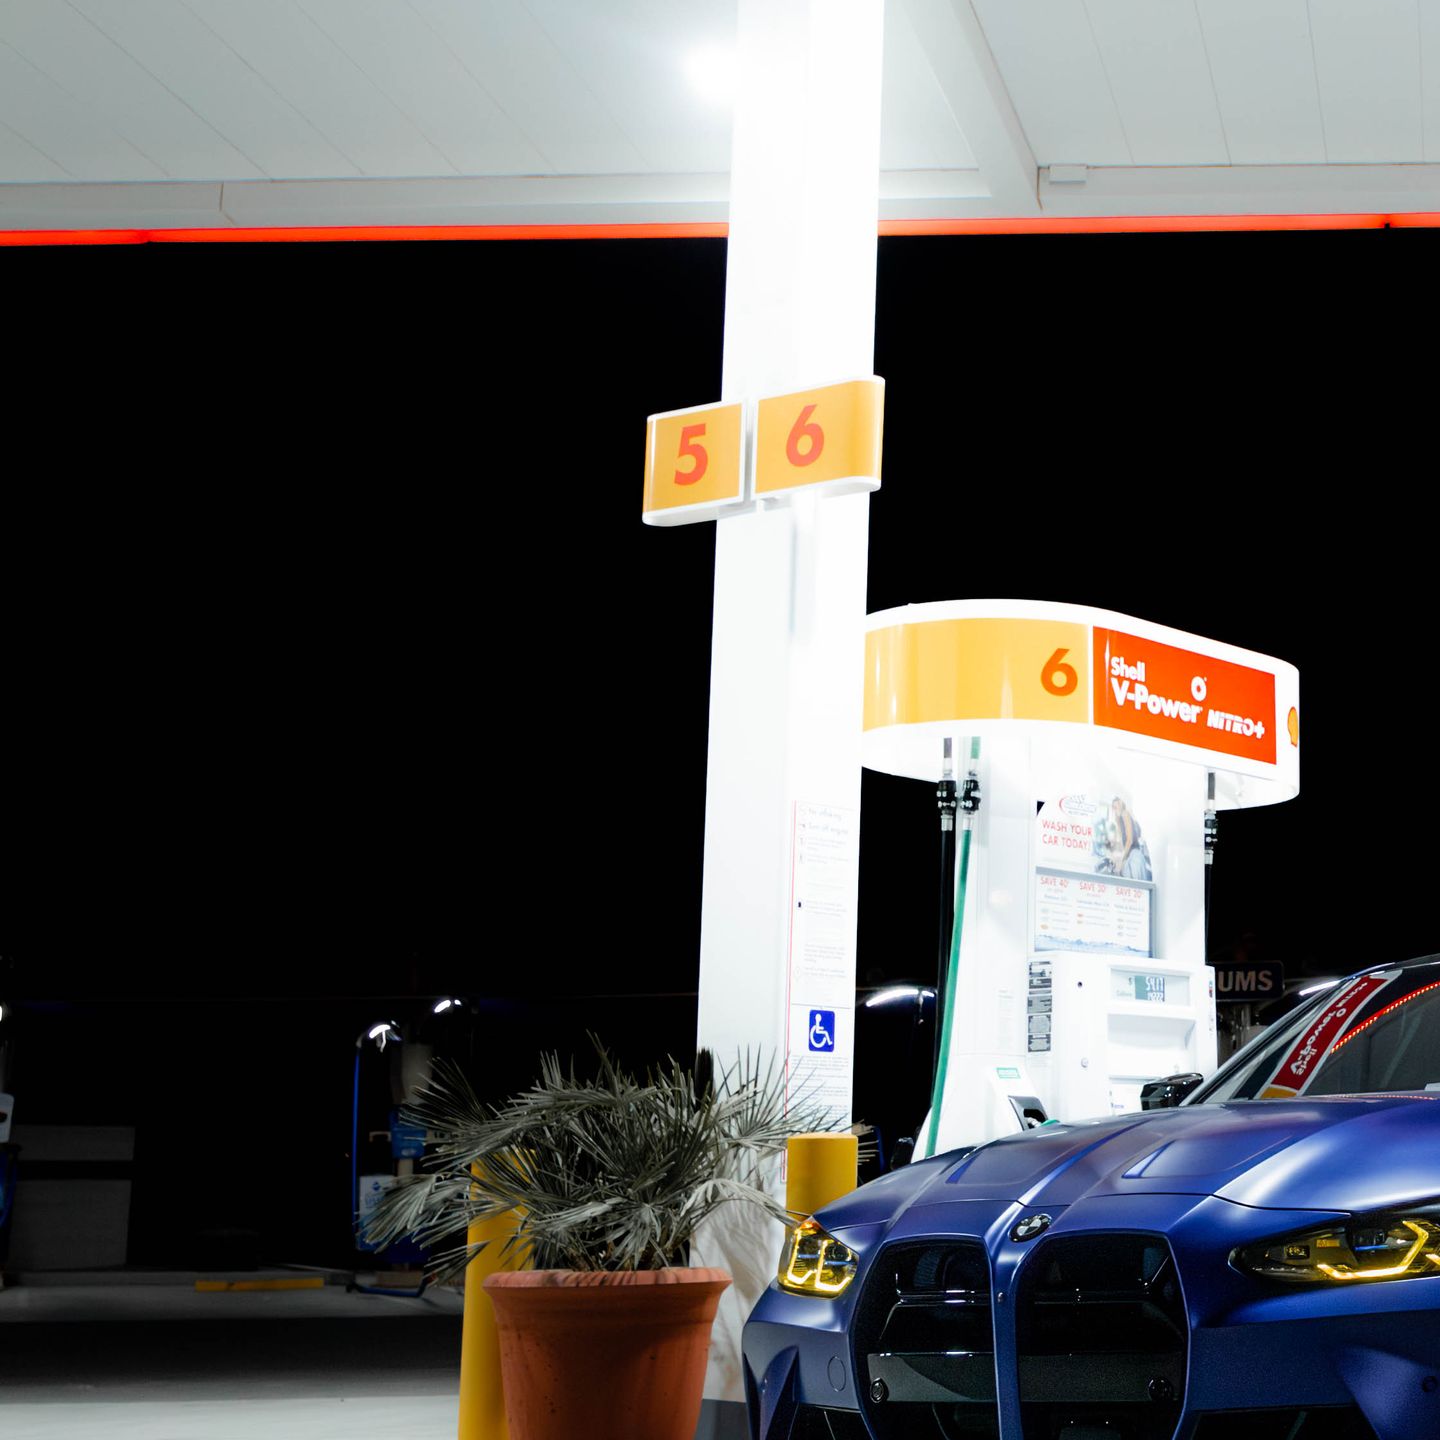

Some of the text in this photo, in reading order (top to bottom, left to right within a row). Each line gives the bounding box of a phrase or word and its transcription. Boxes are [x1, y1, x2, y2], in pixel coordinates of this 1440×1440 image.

[785, 403, 825, 468] 6
[673, 422, 709, 486] 5
[1040, 647, 1078, 697] 6
[1110, 656, 1146, 682] Shell
[1110, 677, 1201, 724] V-Power
[1042, 819, 1093, 837] WASH YOUR
[1042, 833, 1059, 846] CAR
[1040, 876, 1058, 888] SAVE
[1079, 881, 1095, 892] SAVE
[1115, 887, 1131, 897] SAVE
